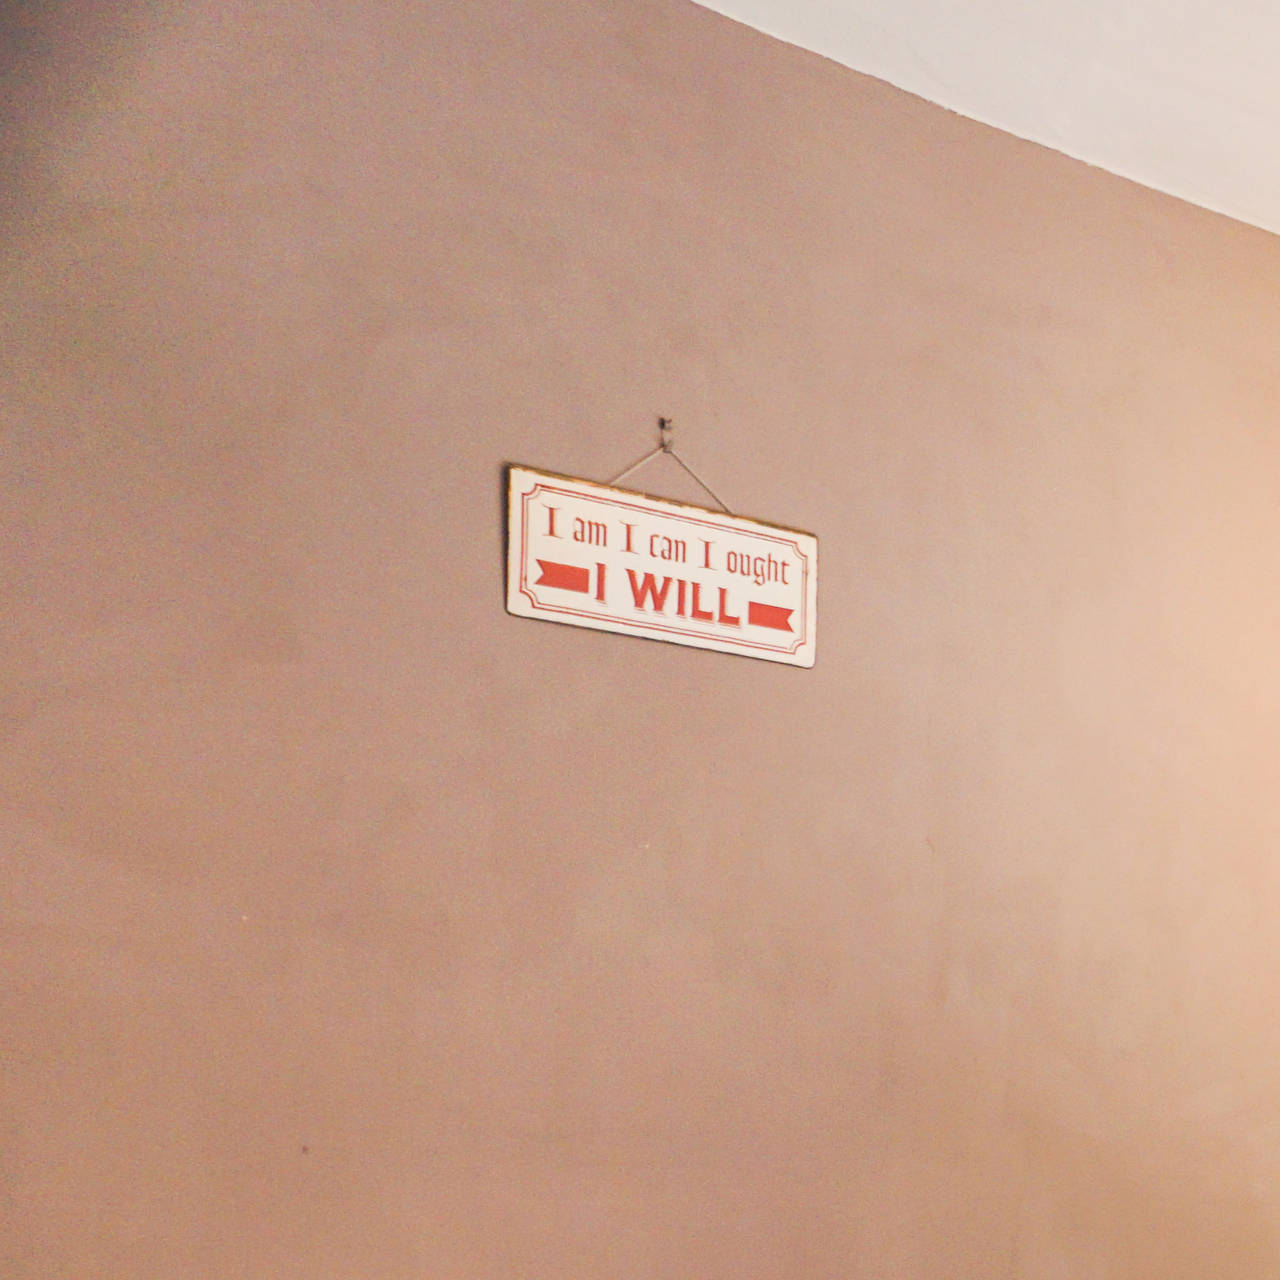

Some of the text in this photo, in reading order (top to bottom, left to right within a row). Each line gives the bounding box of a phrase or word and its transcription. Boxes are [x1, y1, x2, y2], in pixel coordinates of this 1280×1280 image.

[542, 504, 790, 586] I am I can I ought
[596, 562, 741, 627] I WILL
